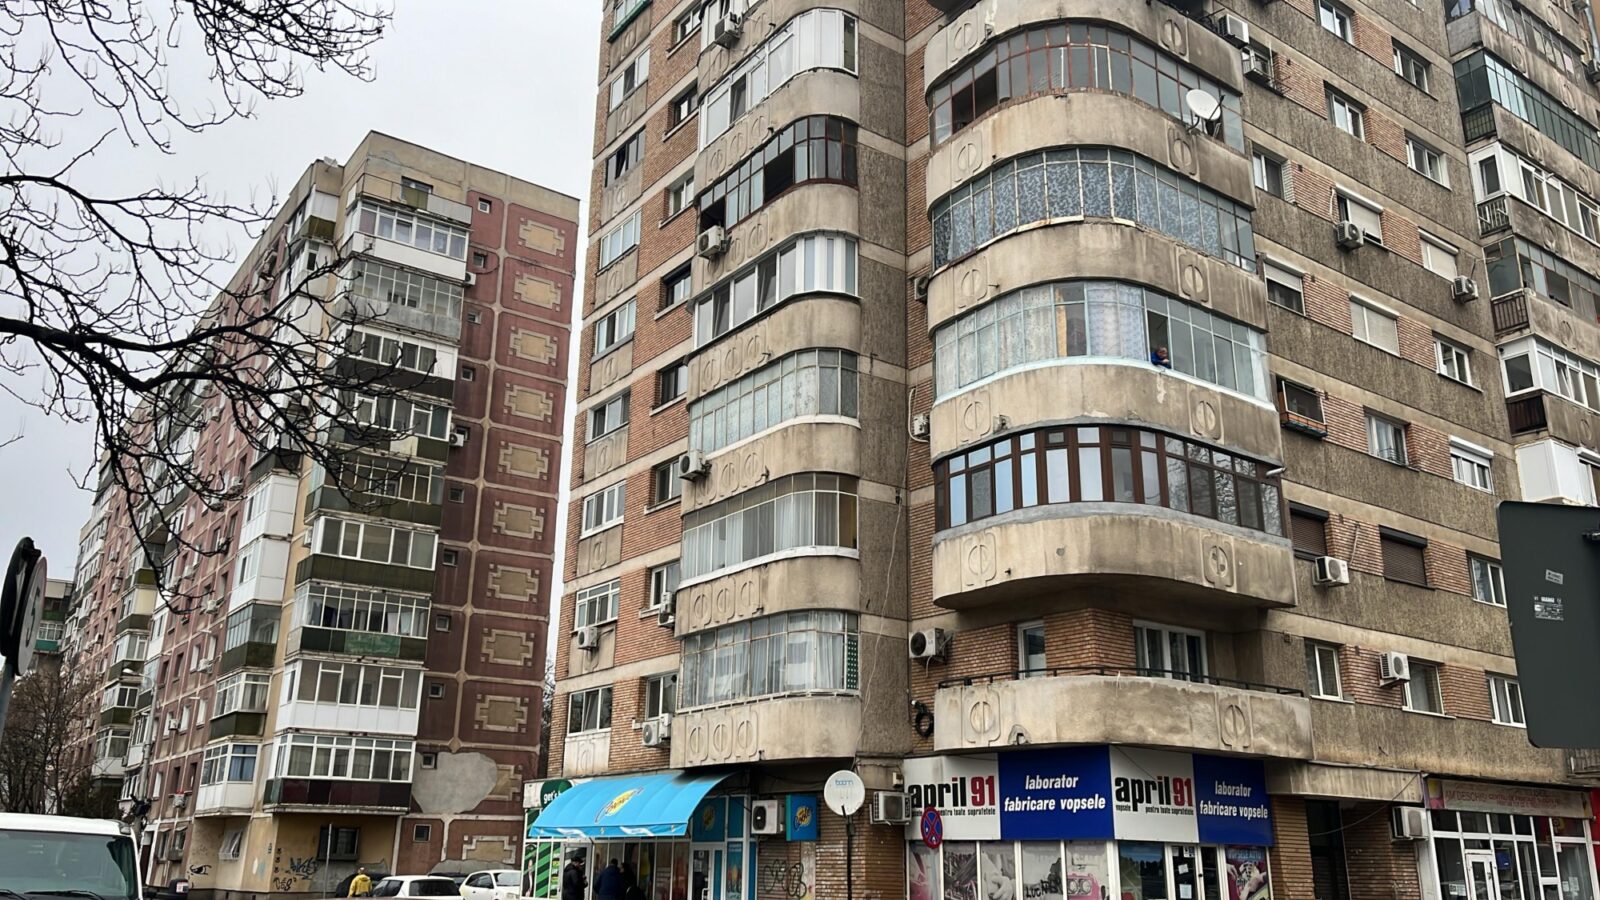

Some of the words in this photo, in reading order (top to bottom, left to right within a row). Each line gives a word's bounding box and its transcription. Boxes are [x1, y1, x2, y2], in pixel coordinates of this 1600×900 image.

[908, 776, 967, 809] april
[971, 775, 996, 807] 91
[1025, 774, 1079, 790] laborator
[1215, 780, 1252, 797] laborator
[1004, 796, 1056, 812] fabricare
[1060, 793, 1106, 813] vopsele
[1114, 776, 1171, 812] april
[1172, 777, 1193, 807] 91
[1199, 800, 1238, 817] fabricare
[1239, 804, 1269, 821] vopsele
